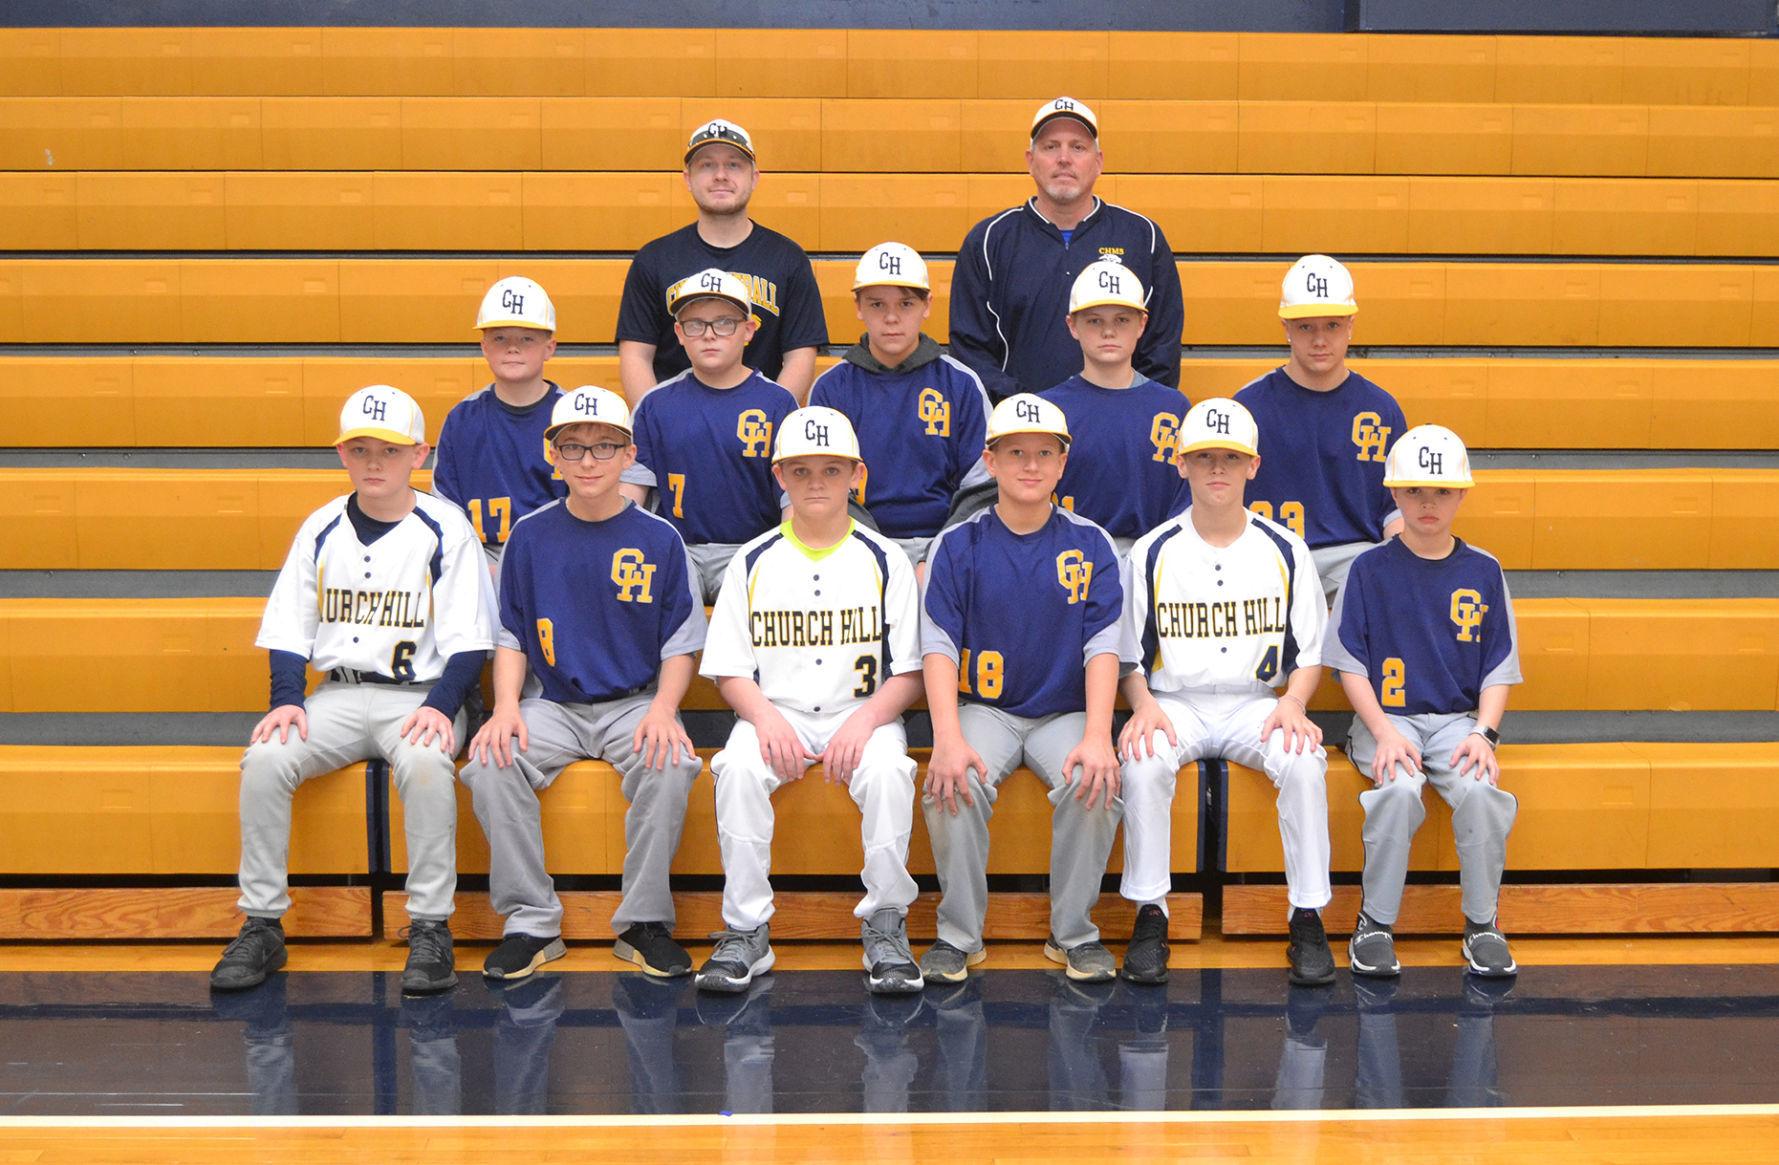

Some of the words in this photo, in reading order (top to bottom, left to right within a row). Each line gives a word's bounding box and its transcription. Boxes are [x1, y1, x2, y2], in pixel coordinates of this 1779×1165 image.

[1054, 99, 1076, 112] CH
[880, 251, 901, 275] CH
[1098, 247, 1125, 256] CHMS
[700, 272, 722, 293] CH
[1098, 271, 1120, 294] CH
[1306, 272, 1329, 298] CH
[501, 288, 525, 315] CH
[362, 395, 386, 421] CH
[575, 393, 598, 416] CH
[1016, 400, 1040, 423] CH
[805, 419, 829, 447] CH
[1206, 408, 1230, 435] CH
[1418, 446, 1443, 475] CH
[667, 472, 686, 519] 7
[467, 496, 512, 544] 17
[751, 609, 834, 648] CHURCH
[839, 605, 882, 646] HILL
[1157, 601, 1238, 639] CHURCH
[1243, 596, 1285, 636] HILL
[391, 639, 418, 681] 6
[959, 647, 1005, 700] 18
[1255, 643, 1281, 683] 4
[852, 653, 877, 699] 3
[1381, 656, 1406, 707] 2
